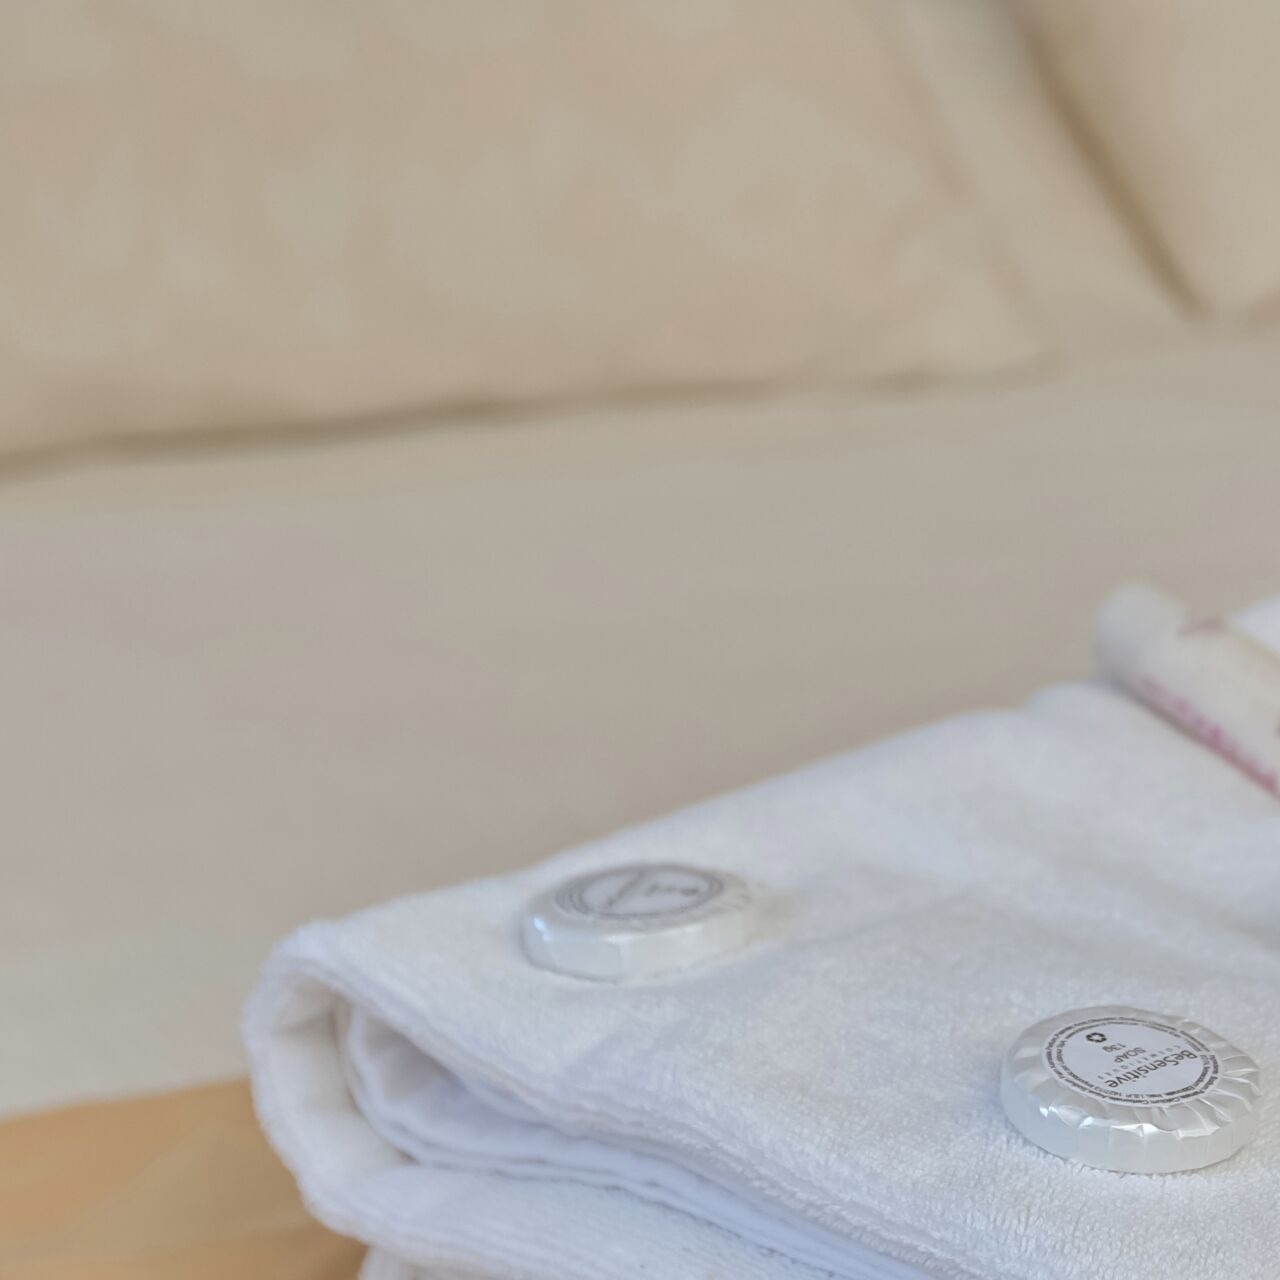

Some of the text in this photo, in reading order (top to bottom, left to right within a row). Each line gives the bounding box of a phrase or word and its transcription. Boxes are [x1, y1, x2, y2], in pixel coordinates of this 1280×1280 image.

[1102, 1042, 1127, 1053] 13g
[1114, 1047, 1147, 1064] SOAP
[1104, 1049, 1198, 1089] BeSensitive
